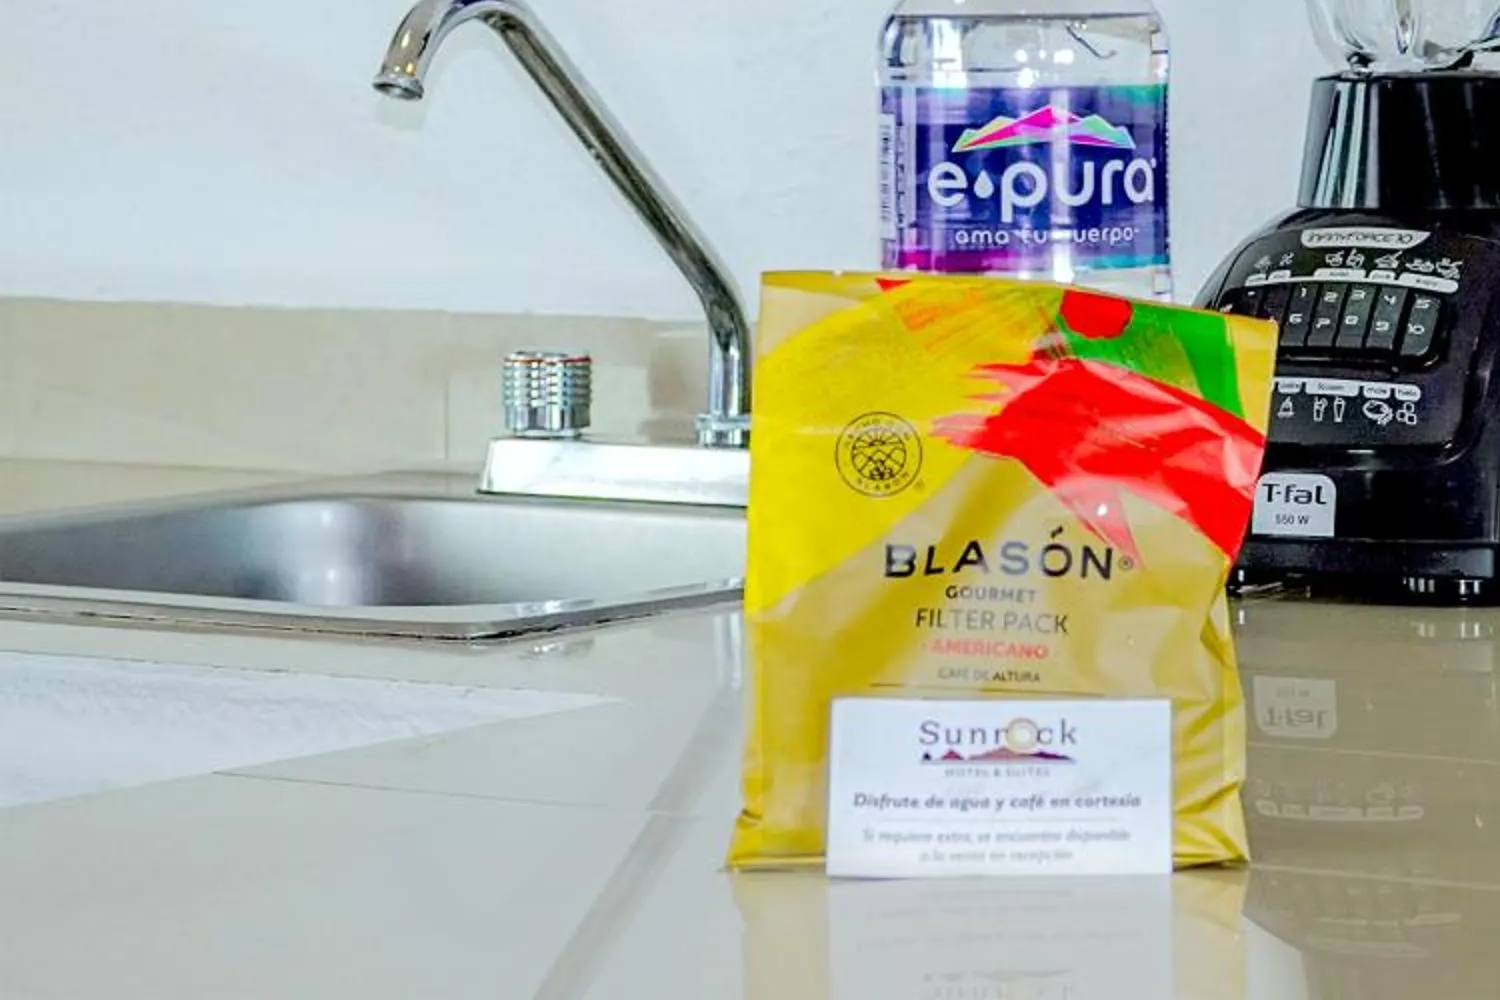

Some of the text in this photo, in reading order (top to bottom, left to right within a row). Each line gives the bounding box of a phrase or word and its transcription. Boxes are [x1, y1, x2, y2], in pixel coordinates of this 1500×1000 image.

[954, 229, 1011, 245] ama
[1055, 227, 1135, 245] uerpo
[1323, 291, 1339, 303] 2
[1261, 483, 1328, 505] T-fal
[1297, 514, 1310, 525] W
[884, 525, 1114, 581] BLASÓN
[944, 584, 1038, 604] GOURMET
[914, 607, 1070, 634] FILTER PACK
[930, 638, 1050, 660] AMERICANO
[992, 669, 1041, 683] ALTURA
[918, 717, 1078, 748] Sunrock
[852, 792, 920, 811] Disfrute
[924, 793, 945, 809] de
[949, 796, 990, 812] agua
[995, 796, 1005, 811] y
[1009, 792, 1046, 812] café
[1049, 796, 1069, 809] en
